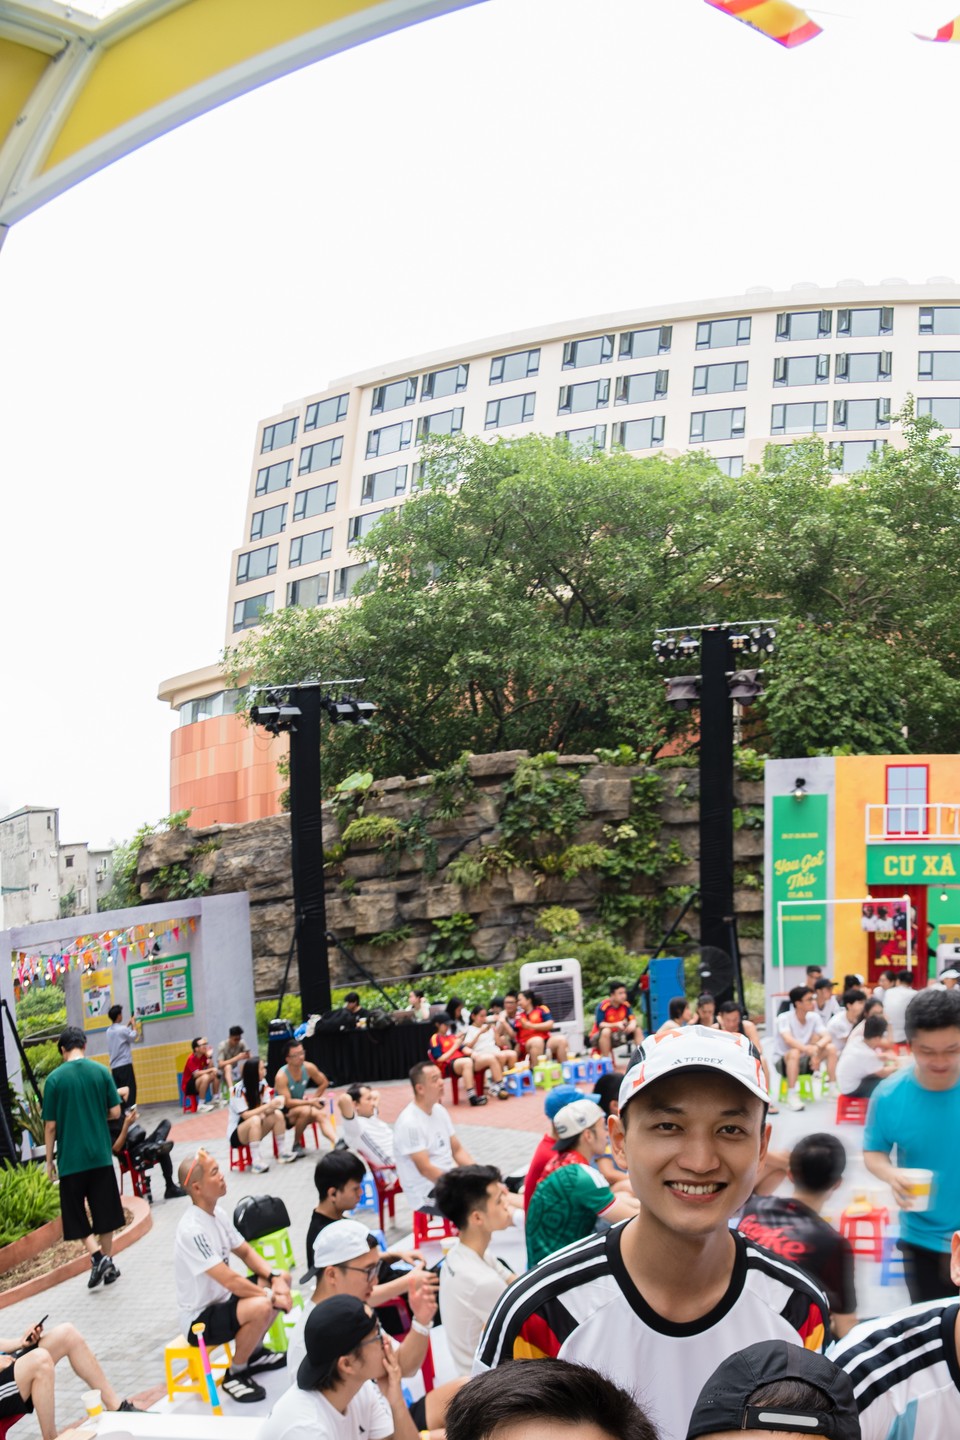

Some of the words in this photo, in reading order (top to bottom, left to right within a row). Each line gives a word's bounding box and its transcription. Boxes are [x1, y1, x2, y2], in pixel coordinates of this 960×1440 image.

[774, 858, 800, 876] You
[800, 850, 825, 873] Got
[922, 853, 956, 876] XÁ
[786, 872, 817, 890] This
